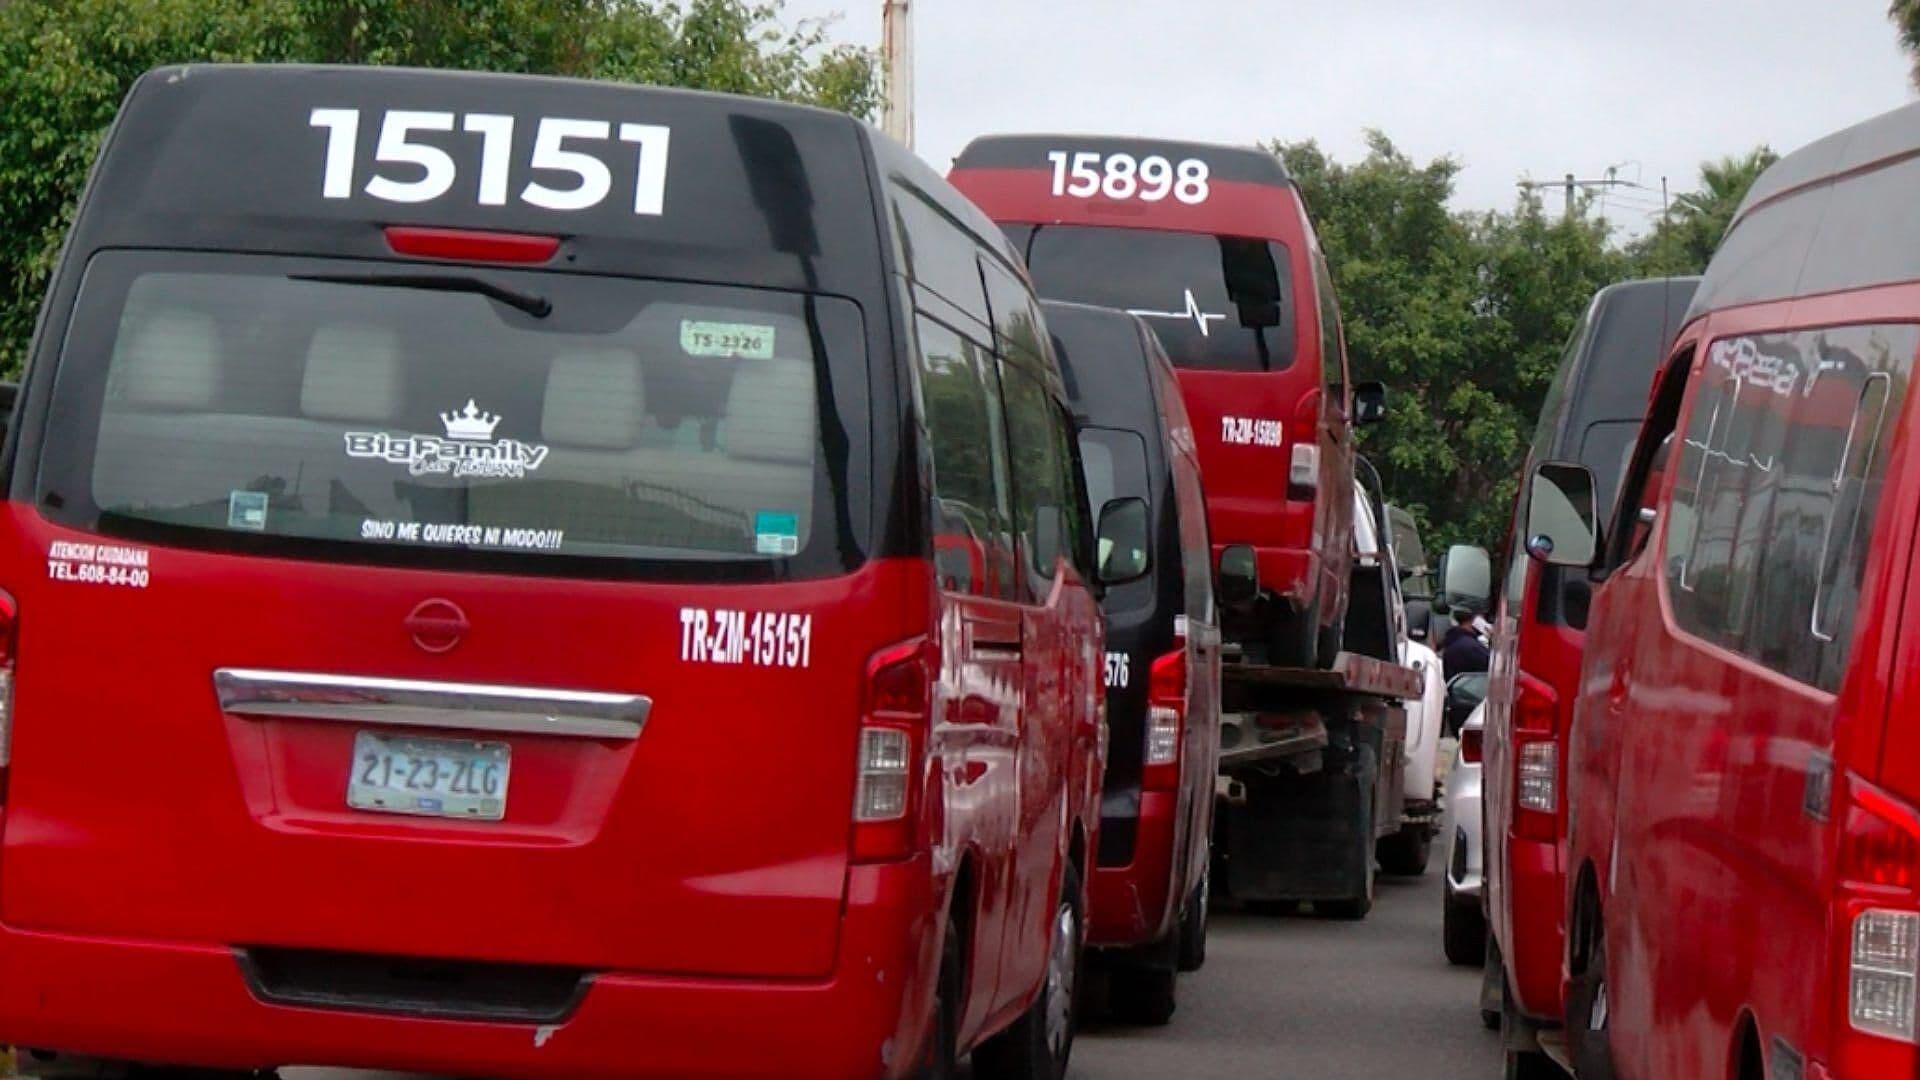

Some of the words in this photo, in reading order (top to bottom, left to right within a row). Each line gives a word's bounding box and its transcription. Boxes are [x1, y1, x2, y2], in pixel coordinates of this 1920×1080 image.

[310, 108, 671, 216] 15151
[1048, 151, 1209, 204] 15898
[344, 432, 548, 469] BigFamily
[361, 519, 393, 538] SINO
[397, 523, 421, 540] ME
[423, 525, 481, 545] QUIERES
[483, 531, 500, 546] NI
[502, 530, 563, 548] MODO!!!
[680, 608, 811, 668] TR-ZM-15151
